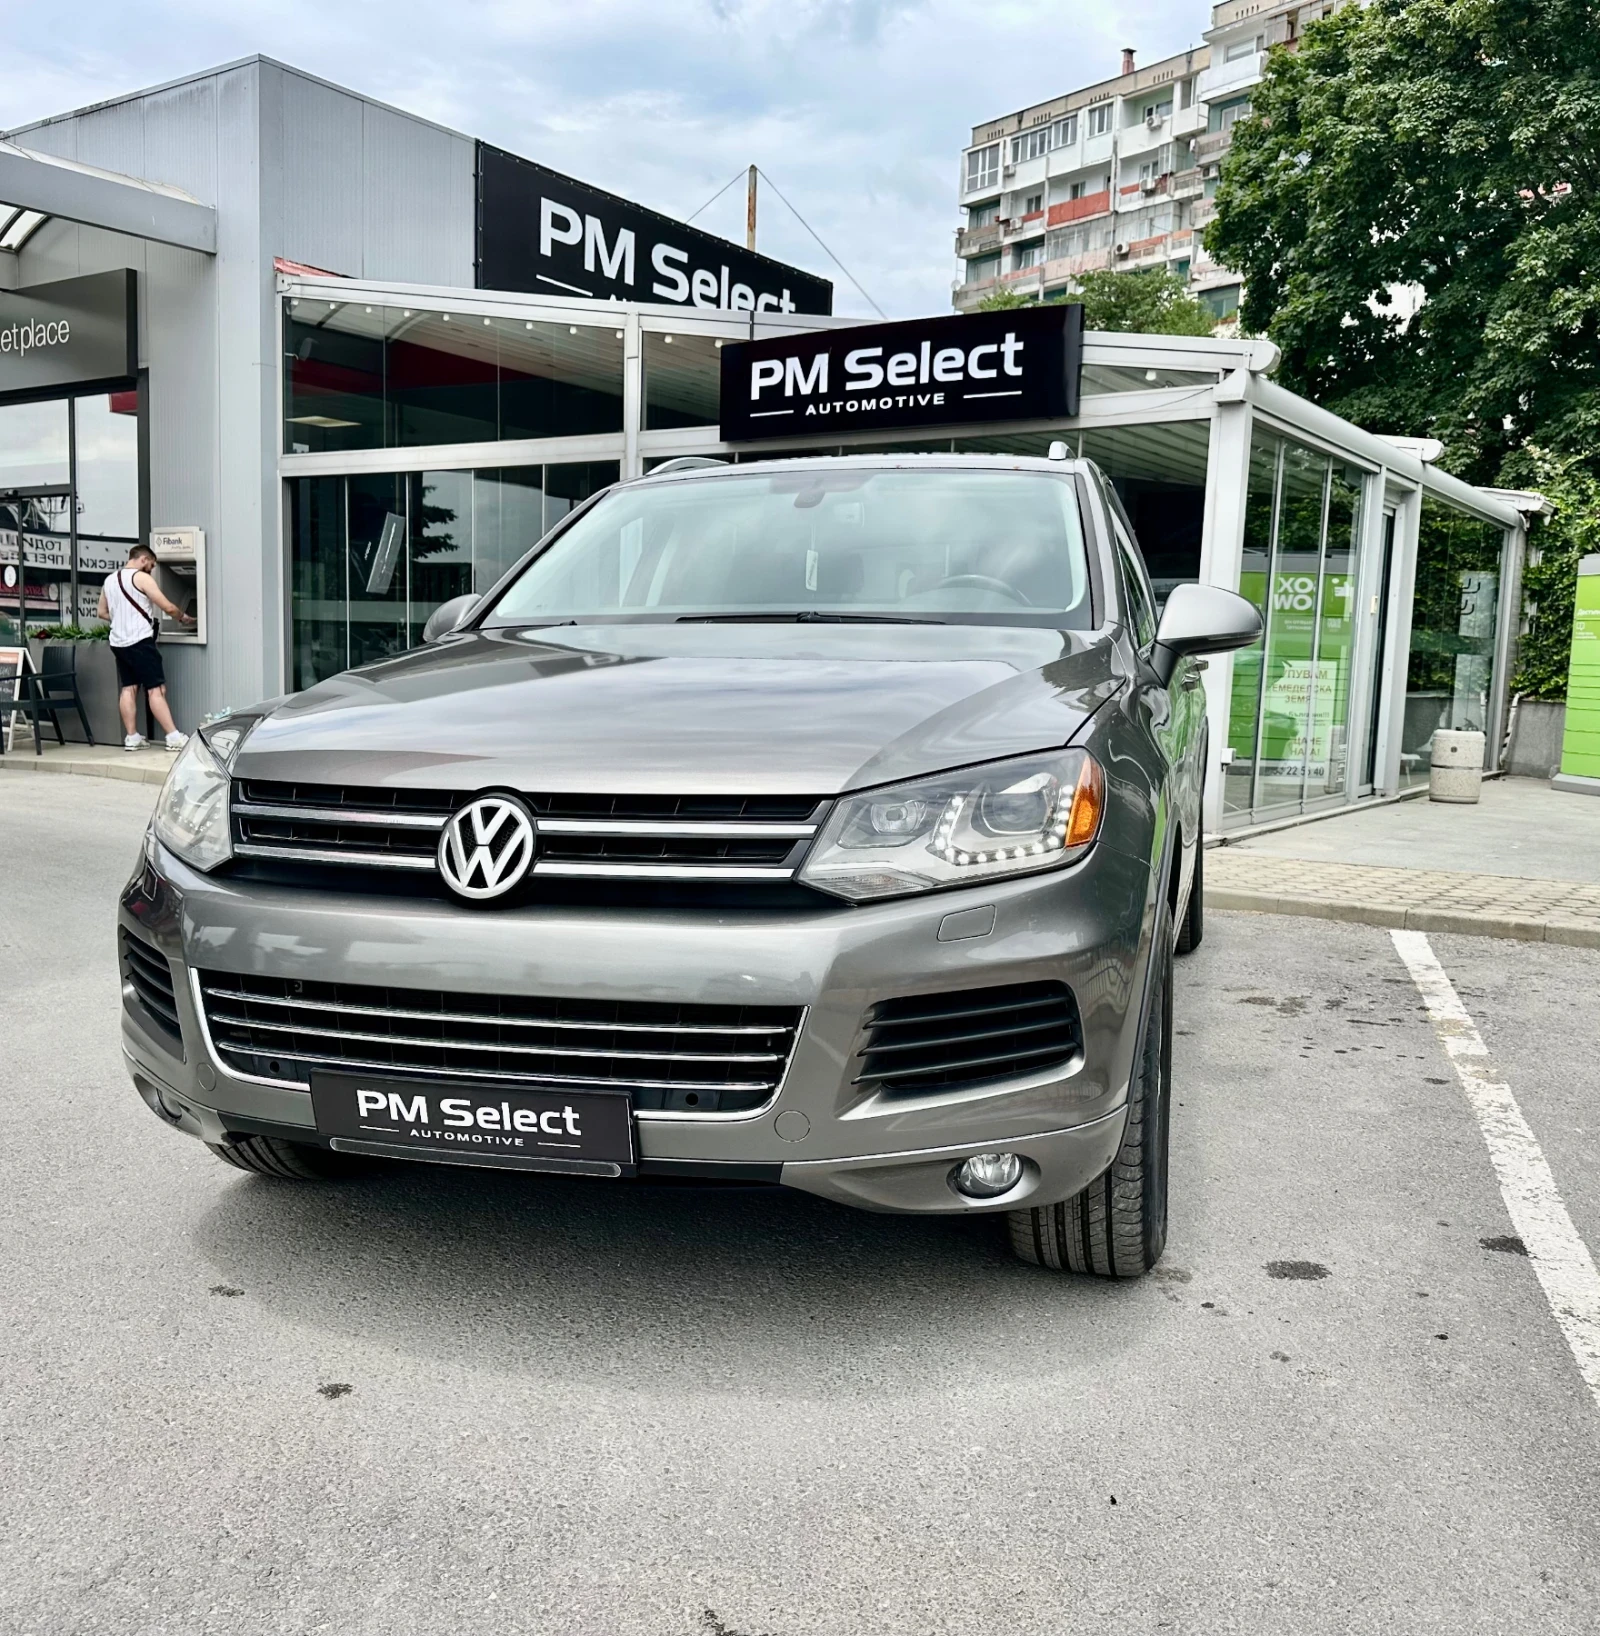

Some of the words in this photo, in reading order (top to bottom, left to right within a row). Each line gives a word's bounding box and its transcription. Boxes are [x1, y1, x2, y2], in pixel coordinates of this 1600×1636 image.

[540, 197, 636, 286] PM
[651, 242, 797, 315] Select
[0, 317, 70, 357] etplace
[751, 353, 830, 400] PM
[844, 332, 1024, 391] Select
[805, 392, 946, 416] AUTOMOTIVE
[162, 537, 182, 545] Fibank
[356, 1089, 429, 1124] PM
[439, 1098, 582, 1136] Select
[409, 1129, 525, 1147] AUTOMOTIVE
